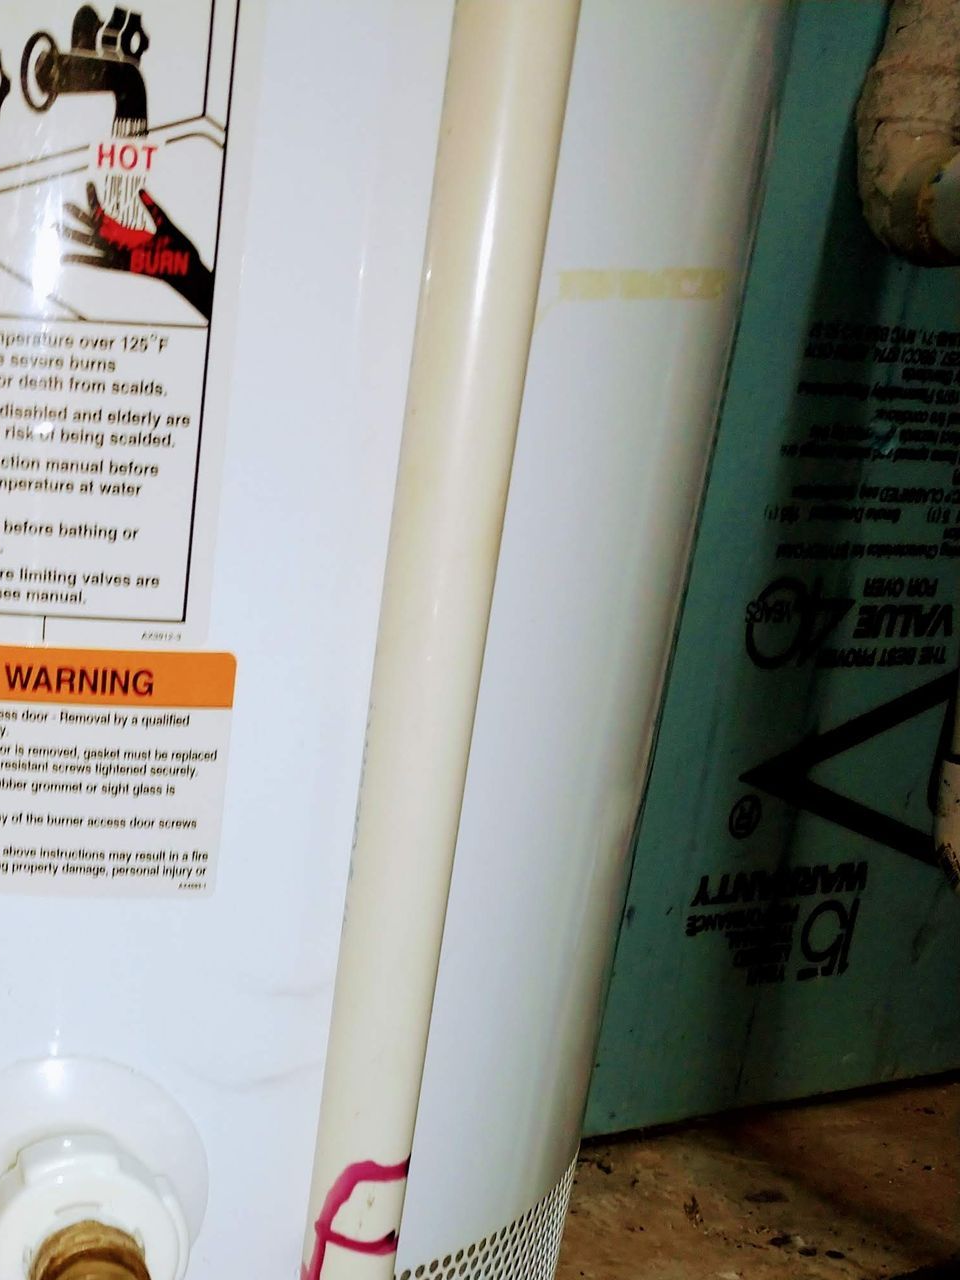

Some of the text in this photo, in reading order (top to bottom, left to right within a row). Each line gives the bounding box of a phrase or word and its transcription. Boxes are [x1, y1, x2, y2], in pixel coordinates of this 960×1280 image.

[97, 143, 158, 171] HOT
[130, 250, 189, 276] BURN
[79, 337, 113, 350] over
[69, 355, 116, 373] burns
[19, 373, 62, 390] death
[69, 376, 105, 392] from
[0, 403, 67, 421] disabled
[73, 407, 102, 423] and
[107, 409, 160, 430] elderly
[166, 414, 191, 428] are
[5, 423, 32, 440] risk
[60, 426, 104, 447] being
[46, 458, 103, 473] manual
[109, 458, 159, 476] before
[80, 479, 93, 494] at
[99, 480, 142, 497] water
[3, 518, 52, 535] before
[59, 520, 117, 542] bathing
[122, 527, 141, 540] or
[19, 565, 76, 587] limiting
[82, 569, 130, 586] valves
[136, 574, 160, 588] are
[907, 577, 938, 597] FOR
[852, 604, 954, 638] VALUE
[5, 664, 155, 696] WARNING
[21, 707, 47, 721] door
[59, 709, 110, 724] Removal
[113, 711, 127, 728] by
[131, 714, 137, 725] a
[141, 713, 190, 729] qualified
[15, 741, 23, 754] is
[83, 744, 119, 760] gasket
[123, 746, 150, 759] must
[154, 746, 167, 759] be
[171, 747, 218, 763] replaced
[0, 757, 48, 771] resistant
[52, 761, 91, 773] screws
[95, 760, 146, 777] tightened
[31, 779, 82, 794] grommet
[86, 782, 96, 793] or
[101, 780, 128, 797] sight
[132, 781, 161, 798] glass
[166, 782, 176, 796] is
[11, 810, 22, 823] of
[26, 810, 43, 824] the
[46, 811, 82, 825] burner
[87, 815, 125, 827] access
[129, 814, 154, 827] door
[159, 817, 198, 829] screws
[3, 841, 36, 855] above
[40, 842, 104, 858] instructions
[108, 848, 131, 862] may
[135, 846, 165, 860] result
[169, 847, 178, 860] in
[182, 850, 188, 860] a
[191, 847, 209, 861] fire
[11, 858, 58, 874] property
[111, 861, 159, 877] personal
[162, 861, 192, 879] injury
[195, 865, 208, 876] or
[690, 861, 868, 907] WARRANTY
